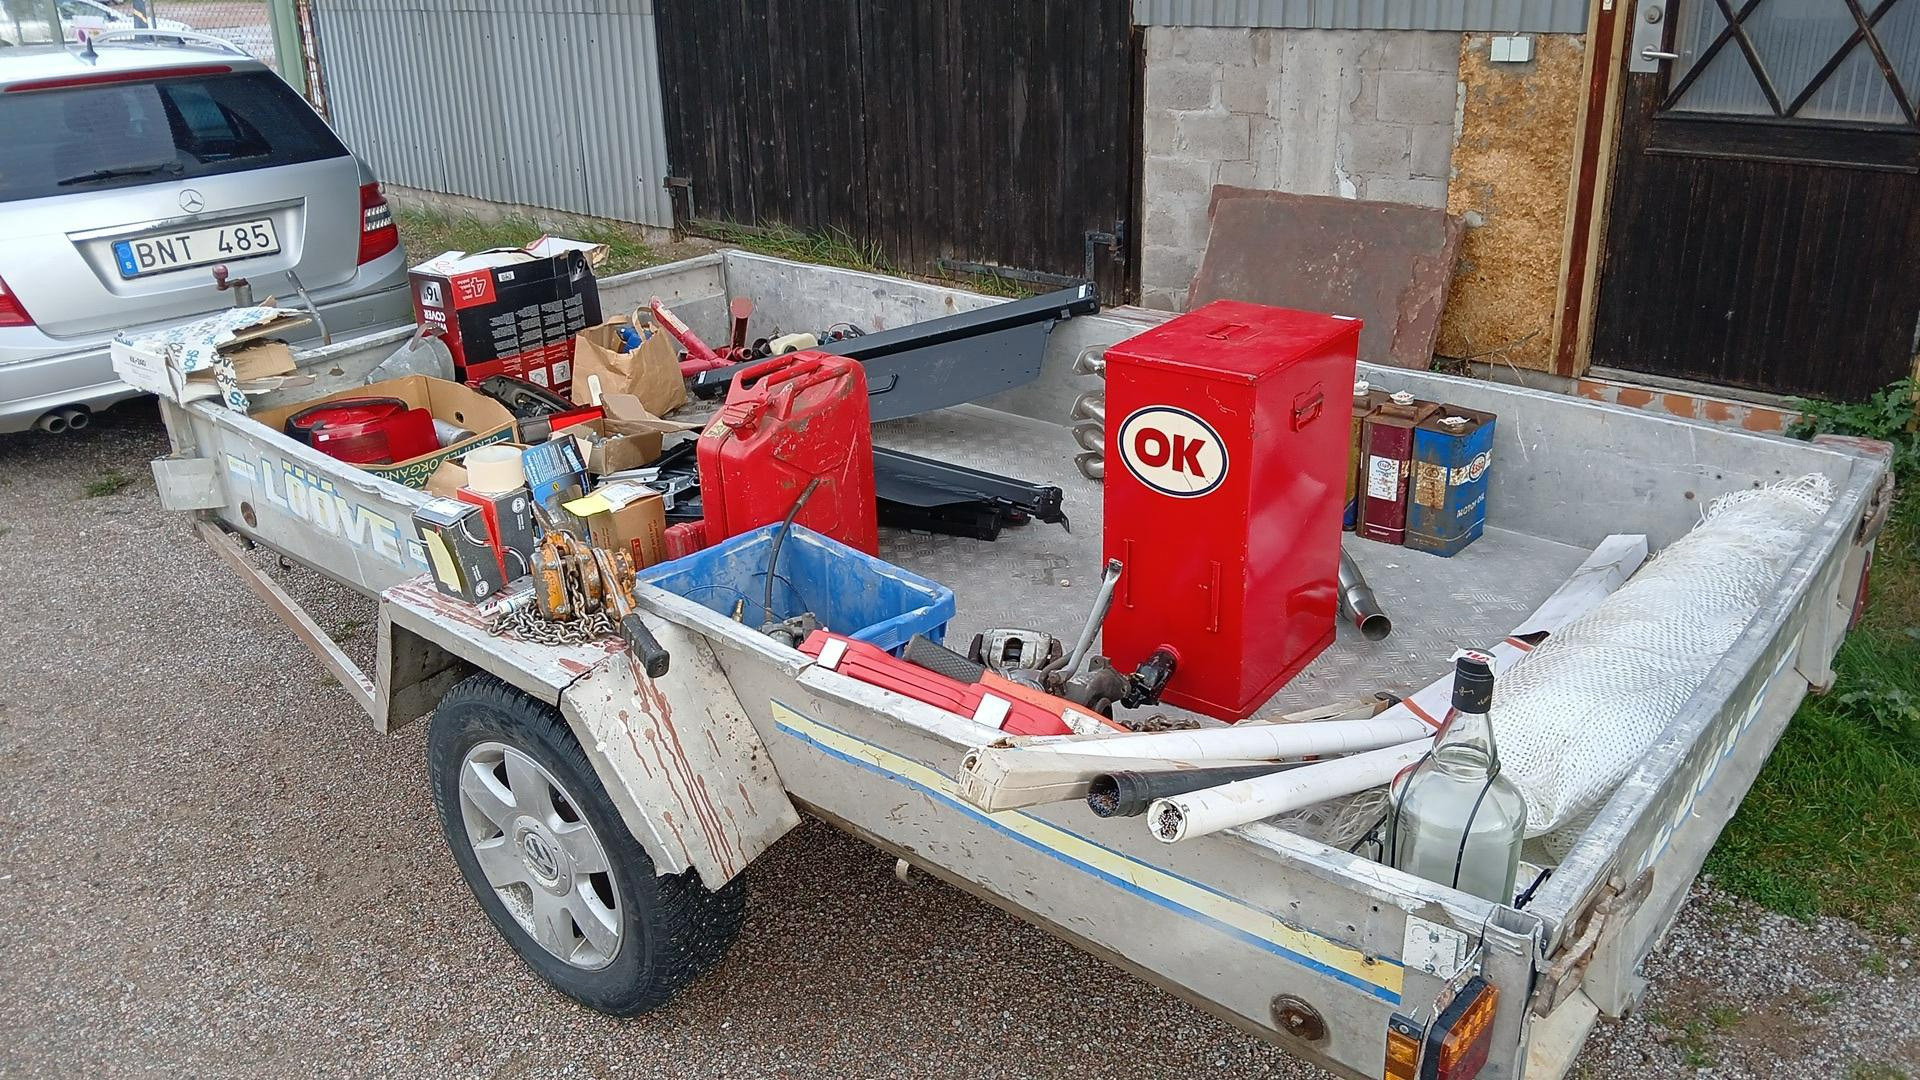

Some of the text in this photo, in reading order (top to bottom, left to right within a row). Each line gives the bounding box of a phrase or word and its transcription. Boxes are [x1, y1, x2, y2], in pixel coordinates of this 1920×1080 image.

[136, 225, 270, 268] BNT 485
[471, 277, 486, 297] 4
[424, 310, 446, 321] COVER
[1134, 427, 1206, 478] OK
